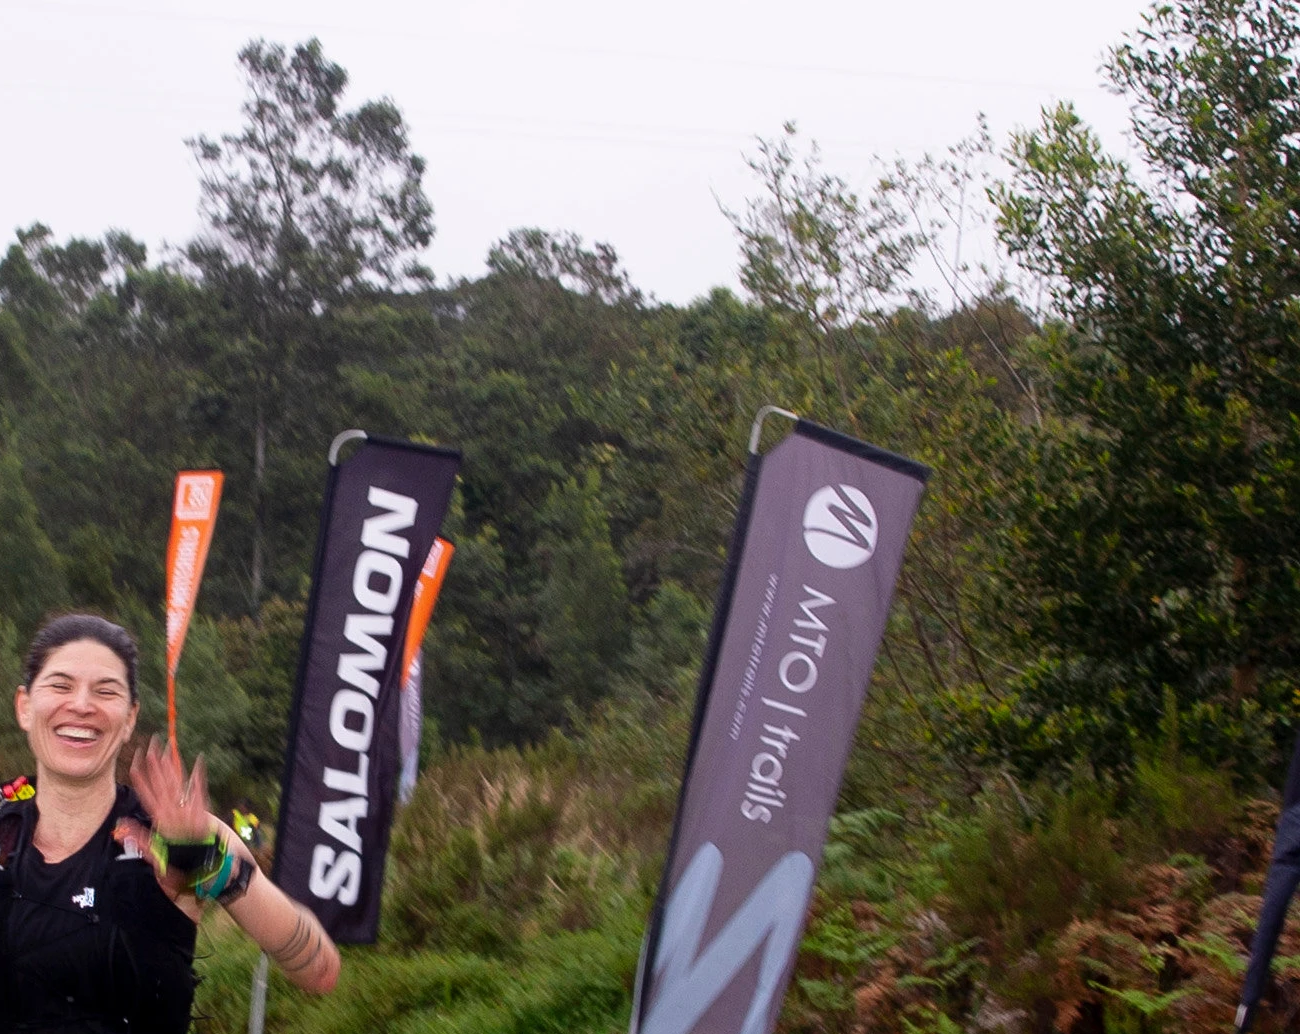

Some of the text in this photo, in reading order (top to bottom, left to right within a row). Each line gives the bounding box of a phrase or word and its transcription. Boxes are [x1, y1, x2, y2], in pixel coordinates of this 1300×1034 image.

[779, 586, 836, 694] MTO
[309, 486, 418, 907] SALOMON
[739, 722, 801, 825] trails
